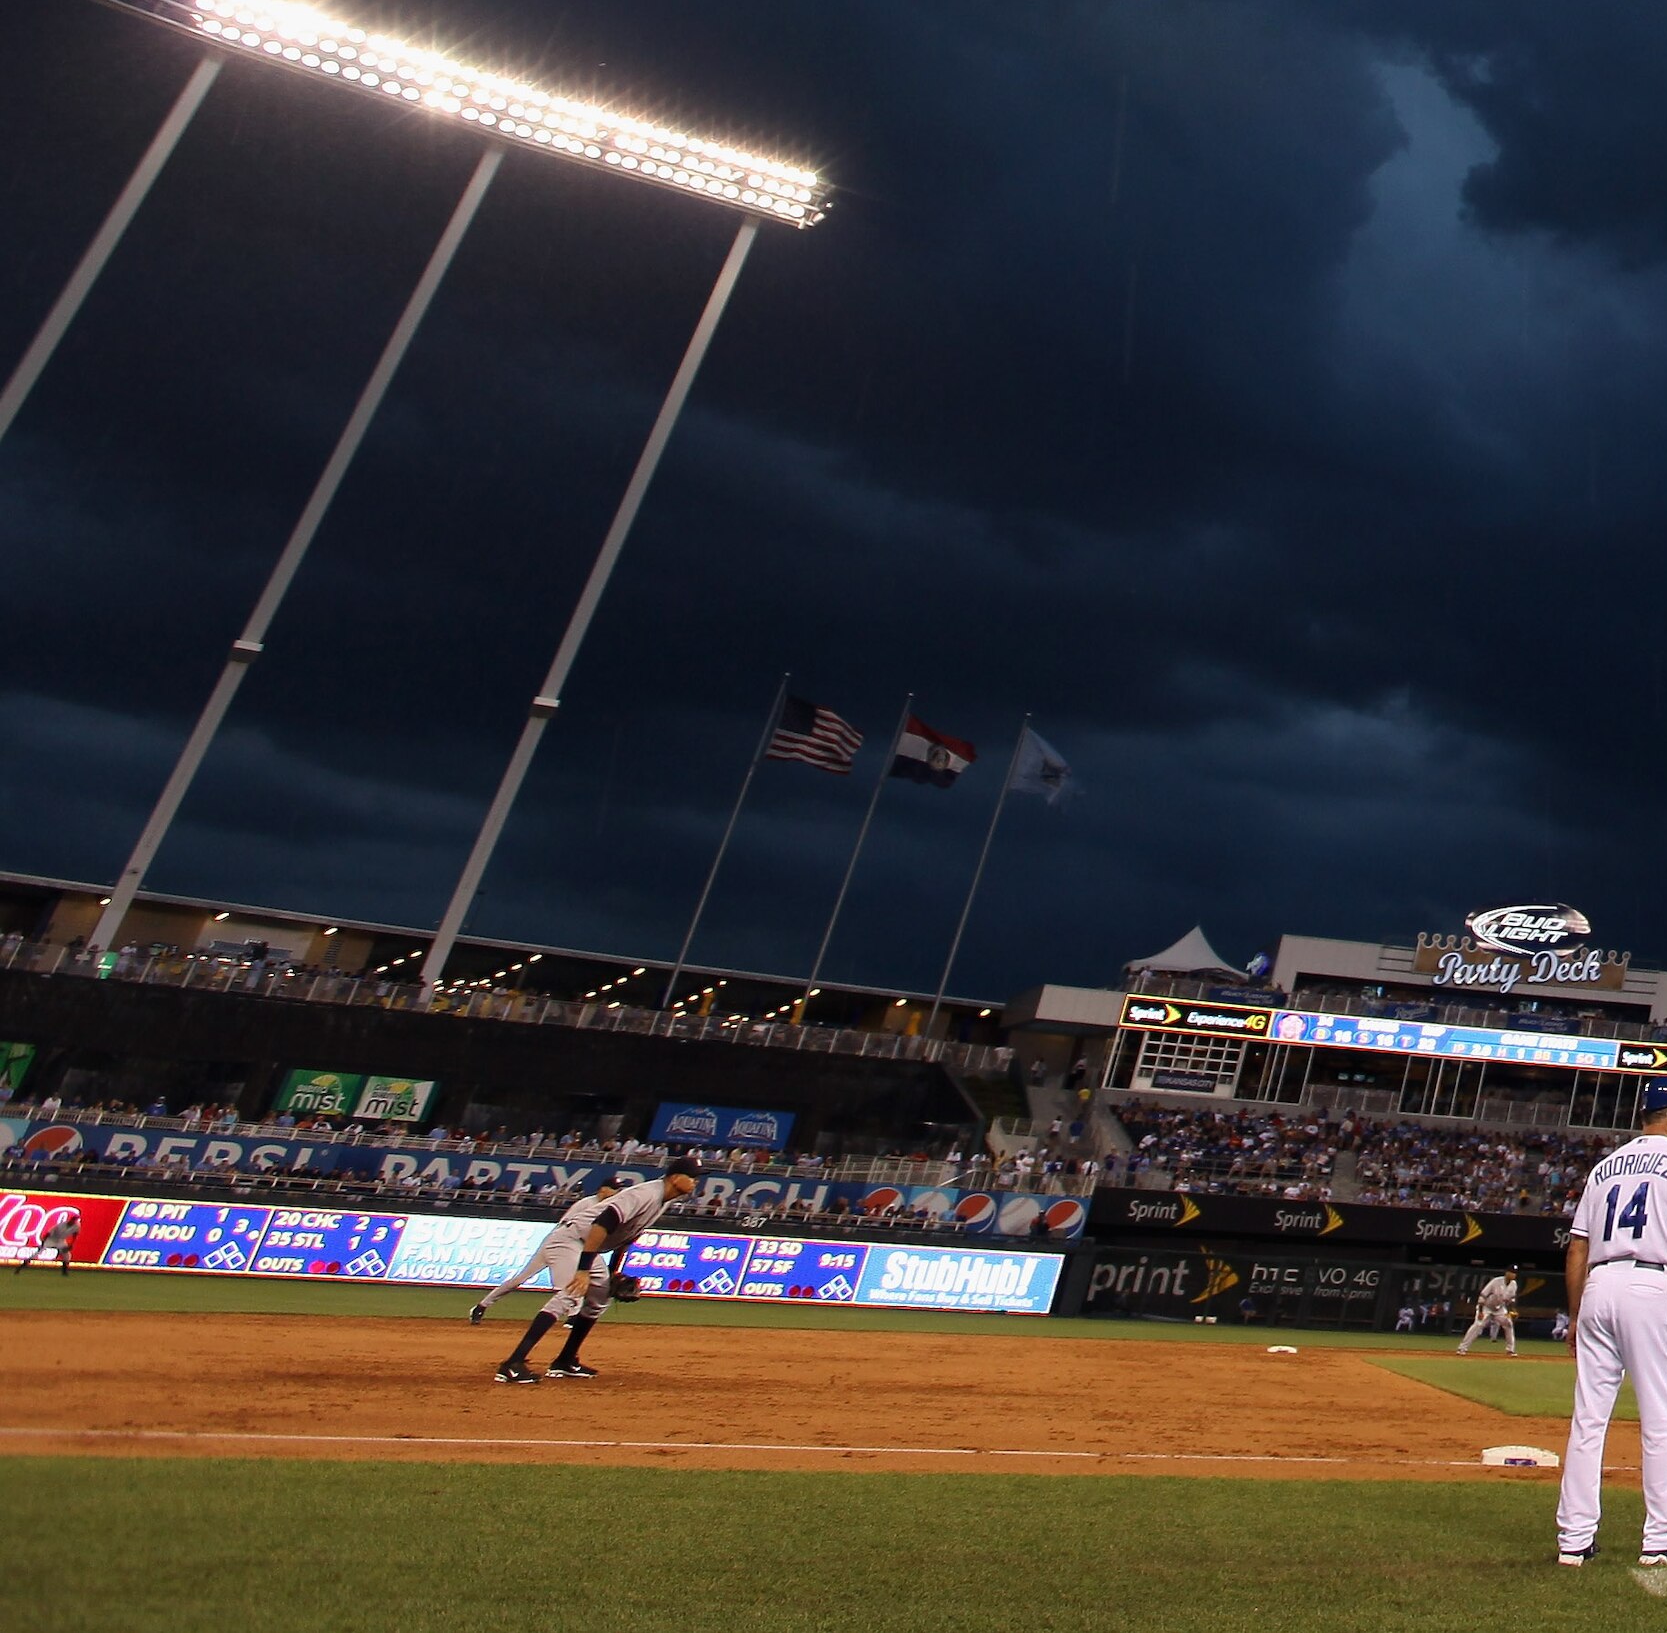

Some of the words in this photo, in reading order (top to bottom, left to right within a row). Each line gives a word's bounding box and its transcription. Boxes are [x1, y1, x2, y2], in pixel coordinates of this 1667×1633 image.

[1502, 912, 1566, 930] BUD
[1484, 924, 1568, 943] LIGHT
[1433, 952, 1521, 993] Party
[1528, 949, 1600, 982] Deck
[1130, 1006, 1166, 1021] Sprint
[1621, 1050, 1655, 1066] Sprint
[288, 1092, 345, 1111] mist
[364, 1097, 419, 1116] mist
[666, 1115, 717, 1135] AQUAFINA
[728, 1119, 777, 1140] AQUAFINA
[104, 1133, 314, 1172] PEPSI
[379, 1153, 597, 1198] PARTY
[612, 1170, 829, 1214] PRCH
[131, 1203, 155, 1218] 49
[158, 1204, 192, 1220] PIT
[217, 1208, 231, 1223] 1
[1128, 1199, 1178, 1223] Sprint
[1602, 1181, 1651, 1242] 14
[233, 1219, 249, 1234] 3
[274, 1212, 302, 1227] 20
[302, 1213, 344, 1229] CHC
[355, 1216, 371, 1231] 2
[741, 1216, 767, 1228] 387
[1273, 1210, 1322, 1233] Sprint
[1415, 1218, 1462, 1240] Sprint
[121, 1223, 148, 1239] 39
[150, 1225, 197, 1241] HOU
[207, 1228, 223, 1242] 0
[266, 1231, 294, 1247] 35
[293, 1233, 325, 1248] STL
[349, 1236, 361, 1250] 1
[371, 1227, 388, 1241] 3
[410, 1218, 533, 1248] SUPER
[659, 1235, 691, 1250] MIL
[757, 1241, 777, 1255] 33
[778, 1242, 804, 1256] SD
[112, 1249, 161, 1264] OUTS
[403, 1245, 452, 1264] FAN
[460, 1247, 531, 1266] NIGHT
[629, 1252, 651, 1266] 29
[652, 1254, 686, 1268] COL
[700, 1246, 740, 1261] 8:10
[819, 1254, 855, 1268] 9:15
[257, 1257, 304, 1272] OUTS
[392, 1263, 471, 1281] AUGUST
[472, 1266, 491, 1282] 18
[751, 1259, 772, 1273] 57
[773, 1260, 795, 1274] SF
[882, 1250, 1036, 1296] StubHub!
[1087, 1256, 1190, 1302] print
[1251, 1263, 1299, 1282] htc
[1353, 1269, 1380, 1286] 4G
[743, 1283, 784, 1296] OUTS
[870, 1287, 907, 1302] Where
[909, 1289, 936, 1303] Fans
[937, 1292, 959, 1306] Buy
[1248, 1282, 1303, 1296] Exclsive
[1313, 1285, 1340, 1298] from
